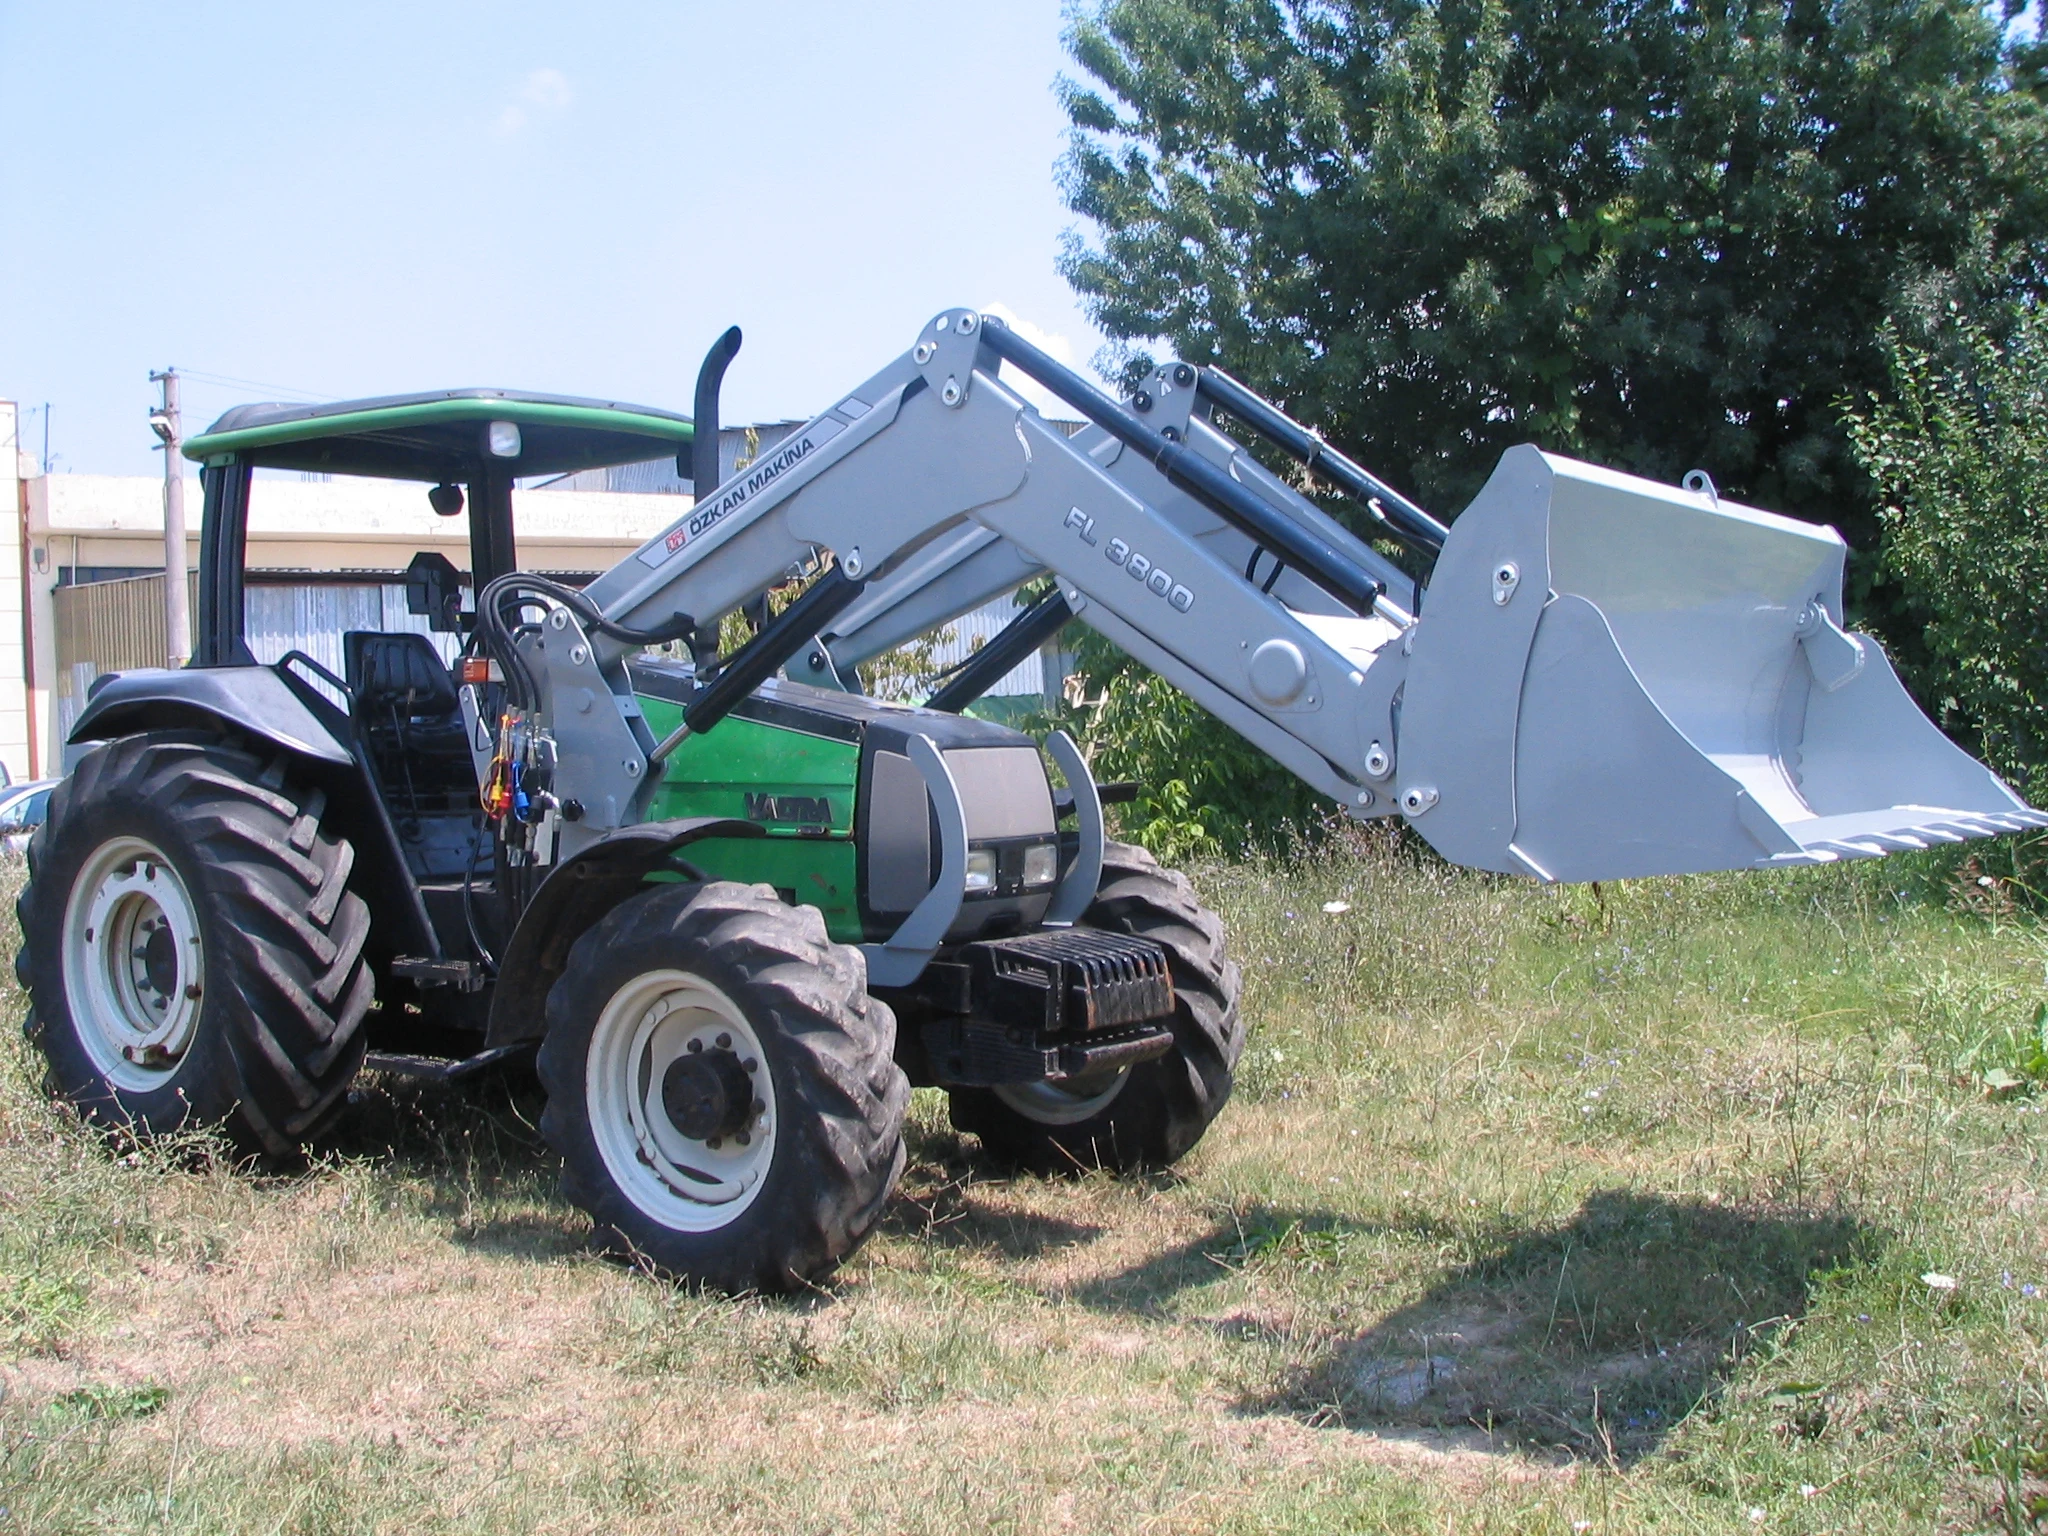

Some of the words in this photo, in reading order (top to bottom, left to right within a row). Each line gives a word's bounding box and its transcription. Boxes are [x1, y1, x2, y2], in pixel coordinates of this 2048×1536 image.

[689, 487, 746, 536] ÖZKAN
[748, 438, 815, 495] MAKİNA
[1063, 506, 1097, 548] FL
[1104, 536, 1196, 614] 3800
